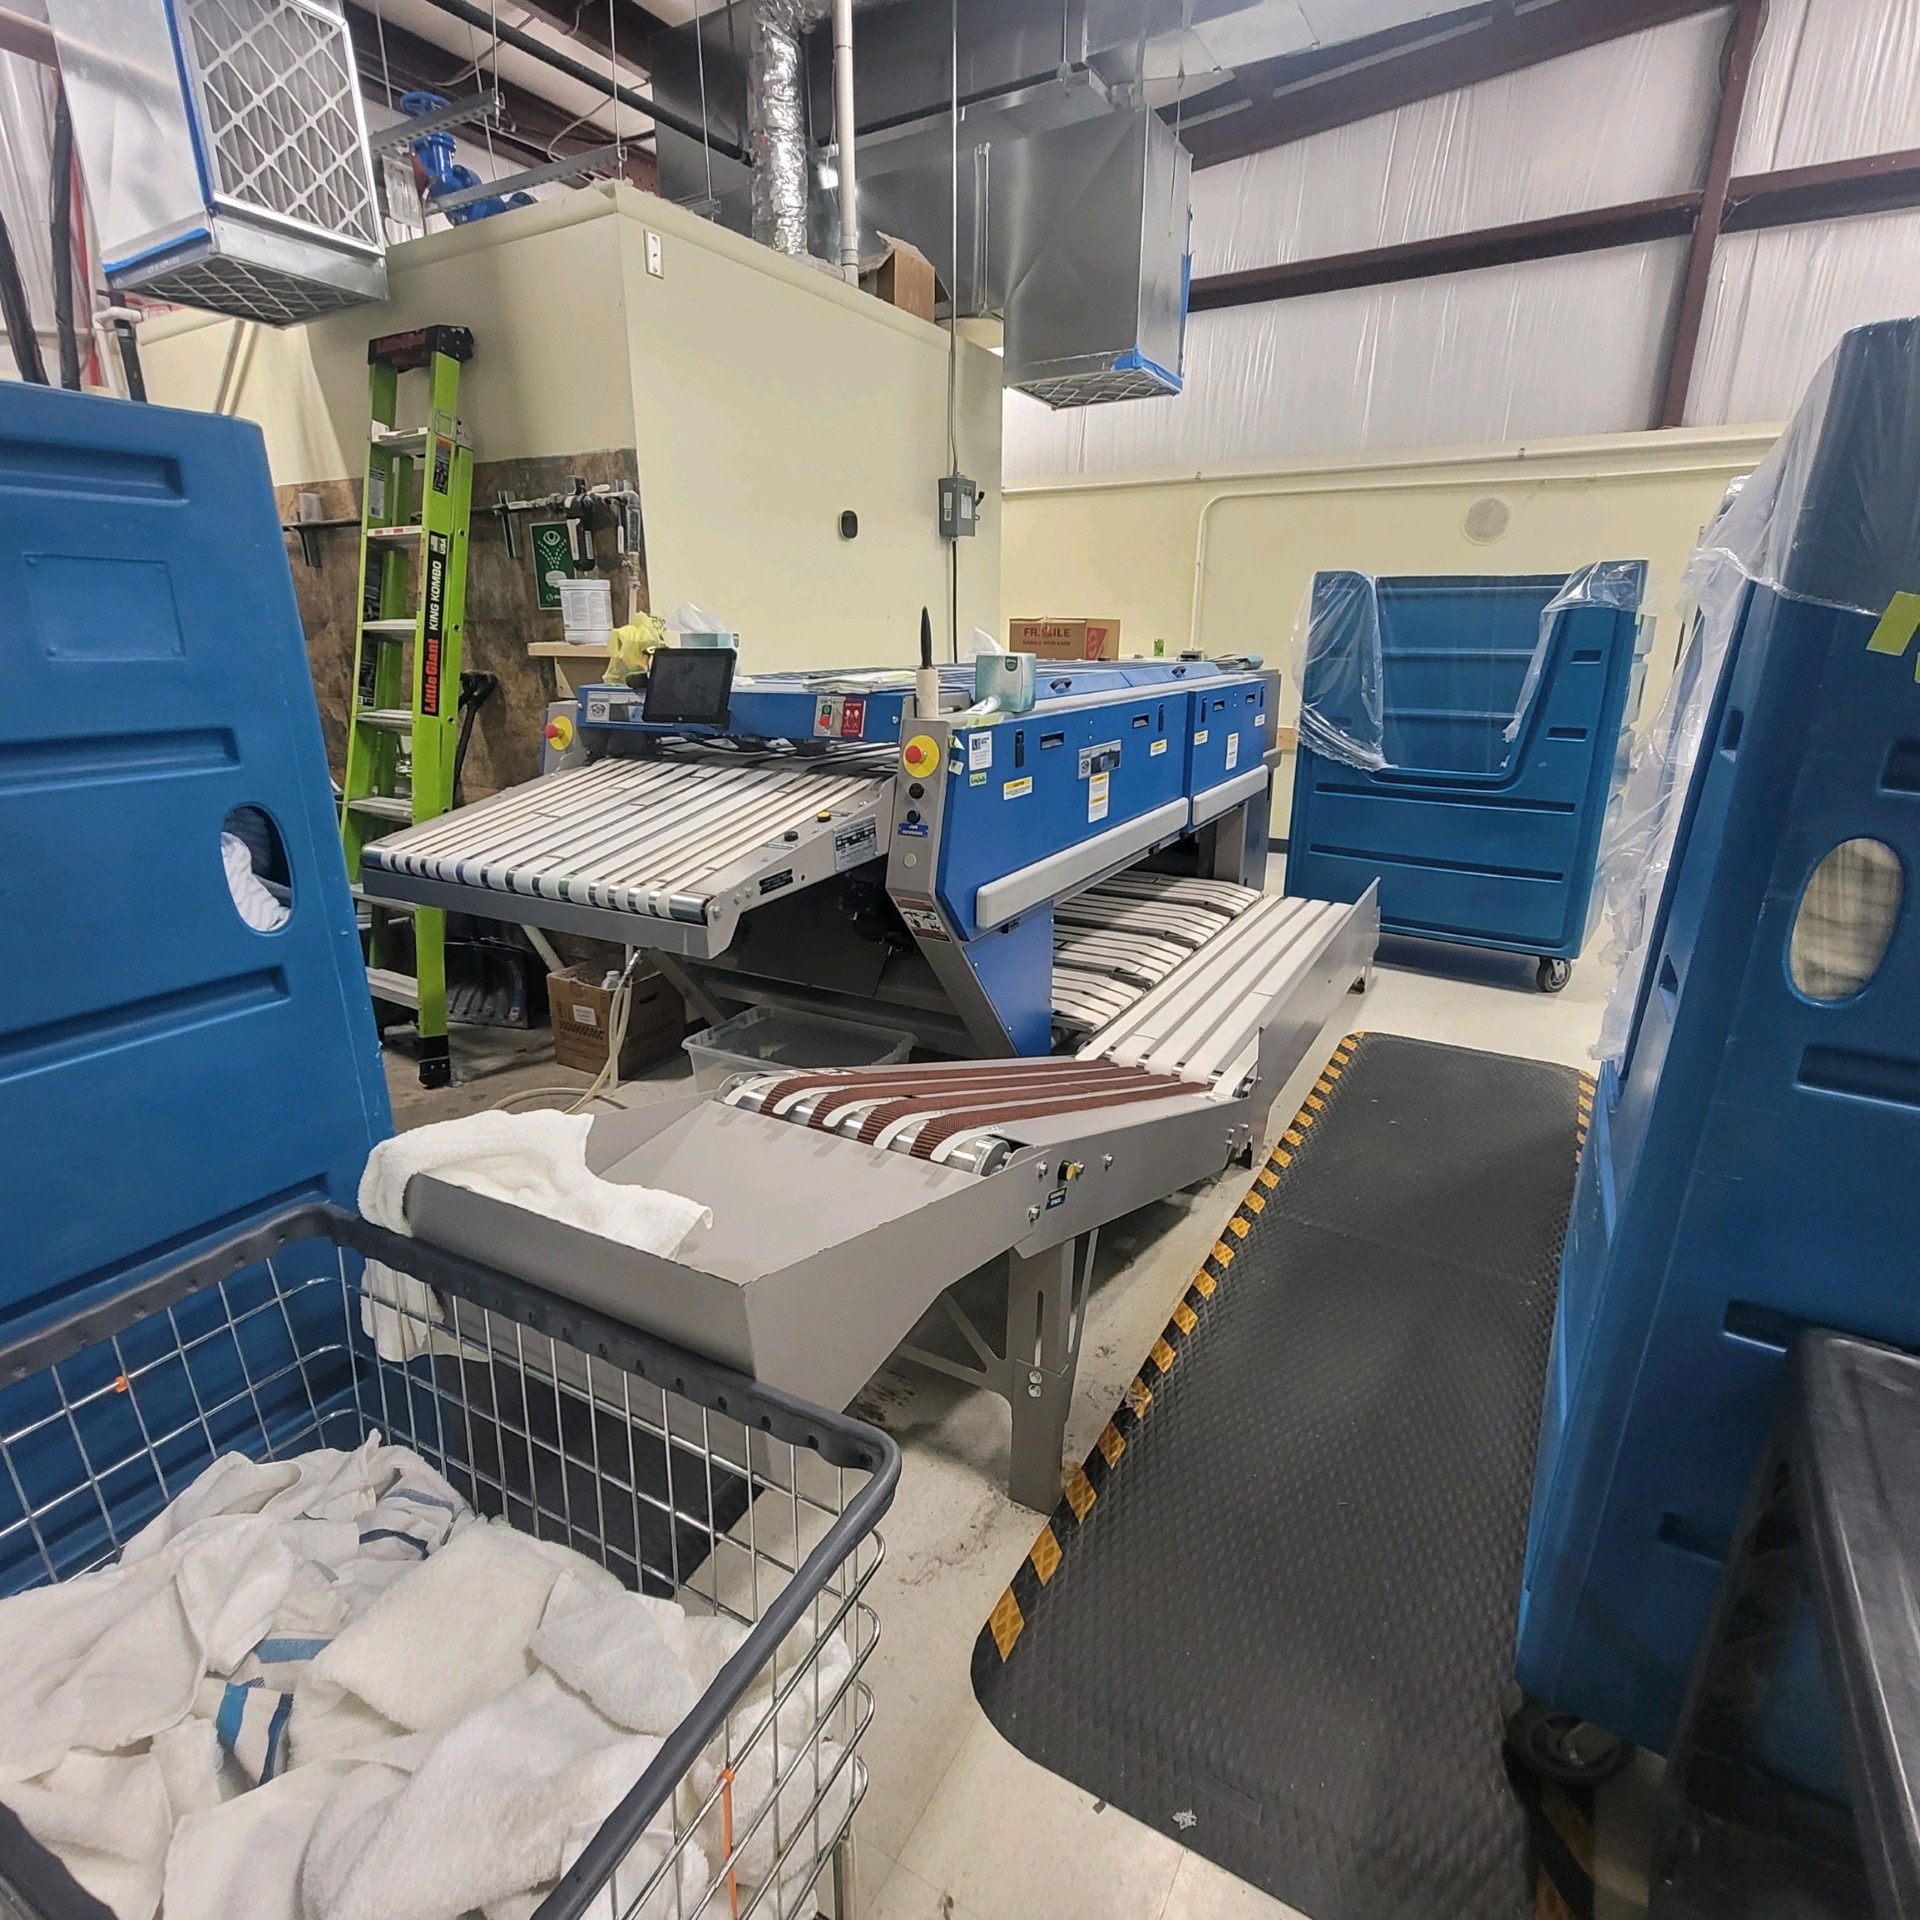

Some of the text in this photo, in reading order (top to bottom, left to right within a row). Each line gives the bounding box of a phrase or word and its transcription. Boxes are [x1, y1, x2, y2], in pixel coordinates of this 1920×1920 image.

[439, 538, 447, 555] USA
[424, 560, 442, 714] Little Giant KING KOMBO
[1023, 627, 1071, 637] FRILE
